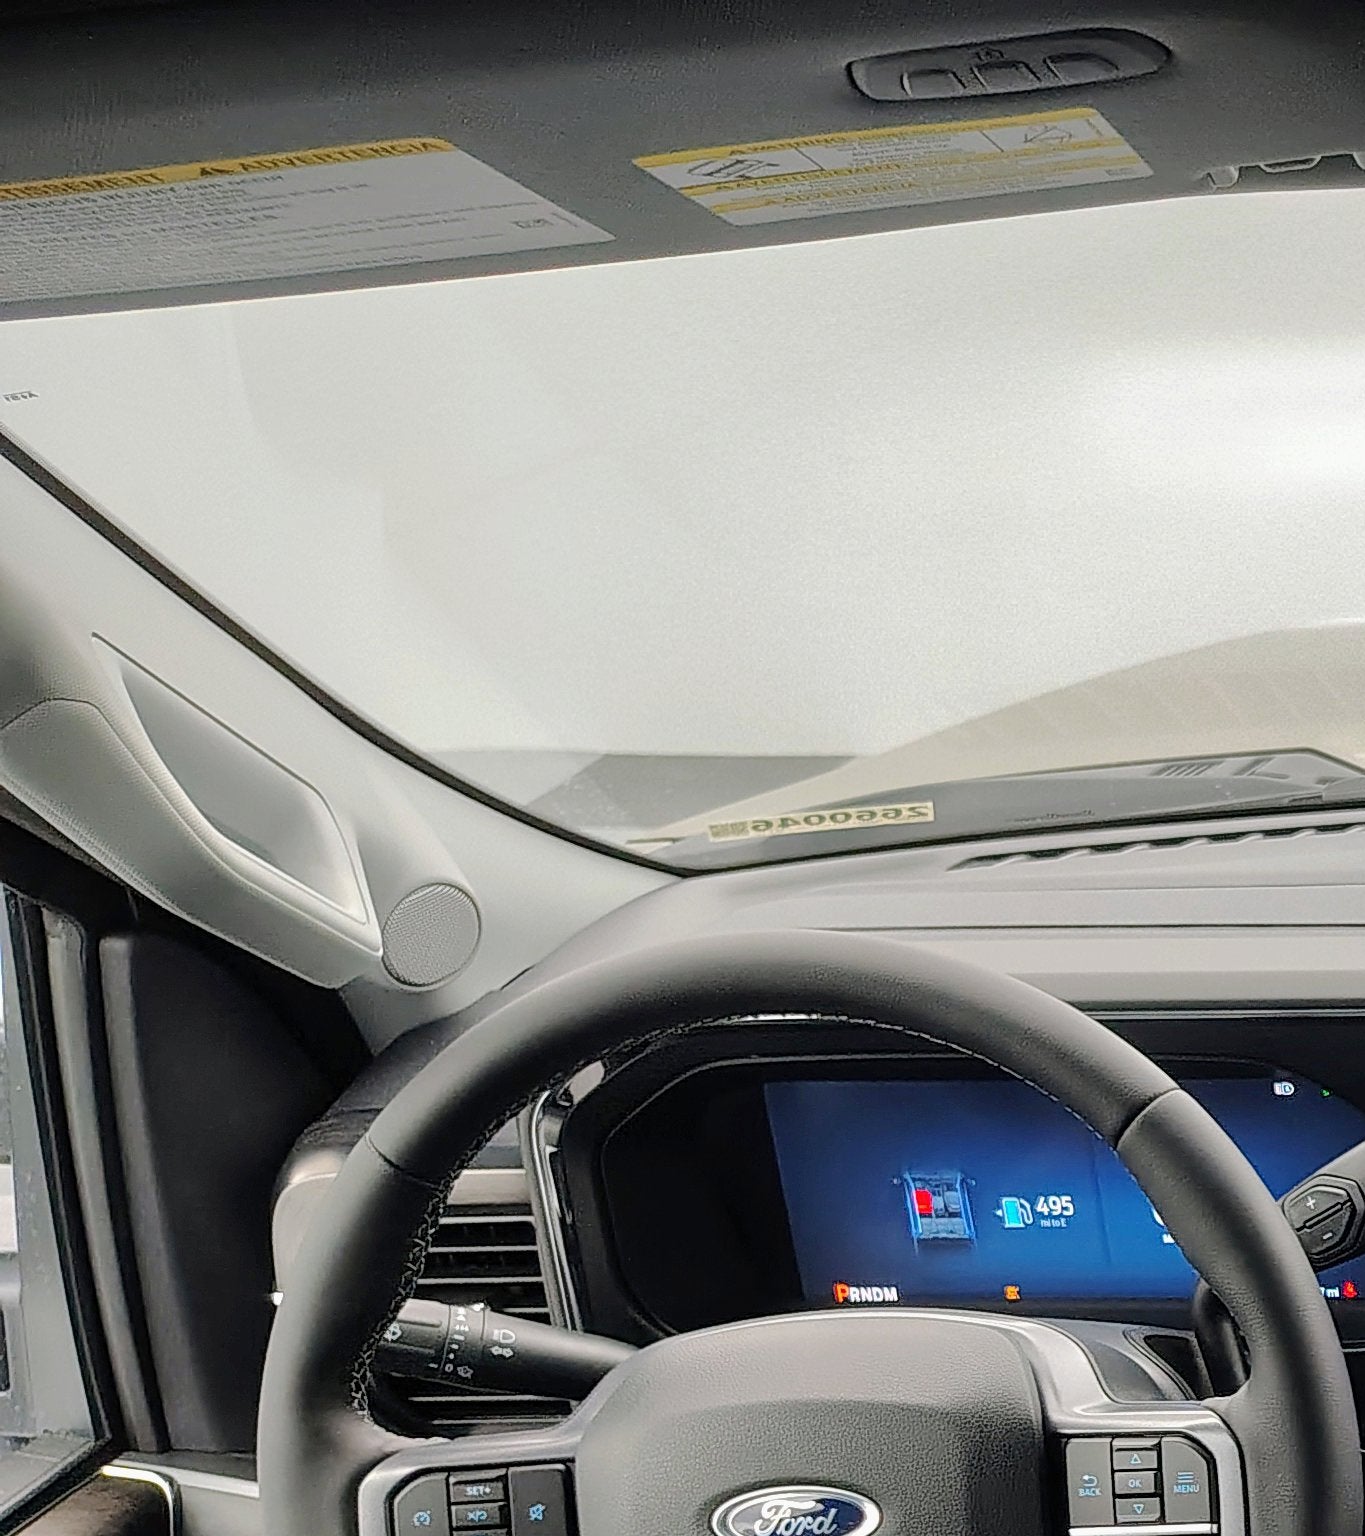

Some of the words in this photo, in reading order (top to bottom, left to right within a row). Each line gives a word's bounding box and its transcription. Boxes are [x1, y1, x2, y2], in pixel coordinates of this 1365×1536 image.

[1035, 1195, 1074, 1217] 495
[1128, 1479, 1142, 1488] OK
[1078, 1488, 1101, 1497] BACK
[1174, 1484, 1200, 1493] MENU
